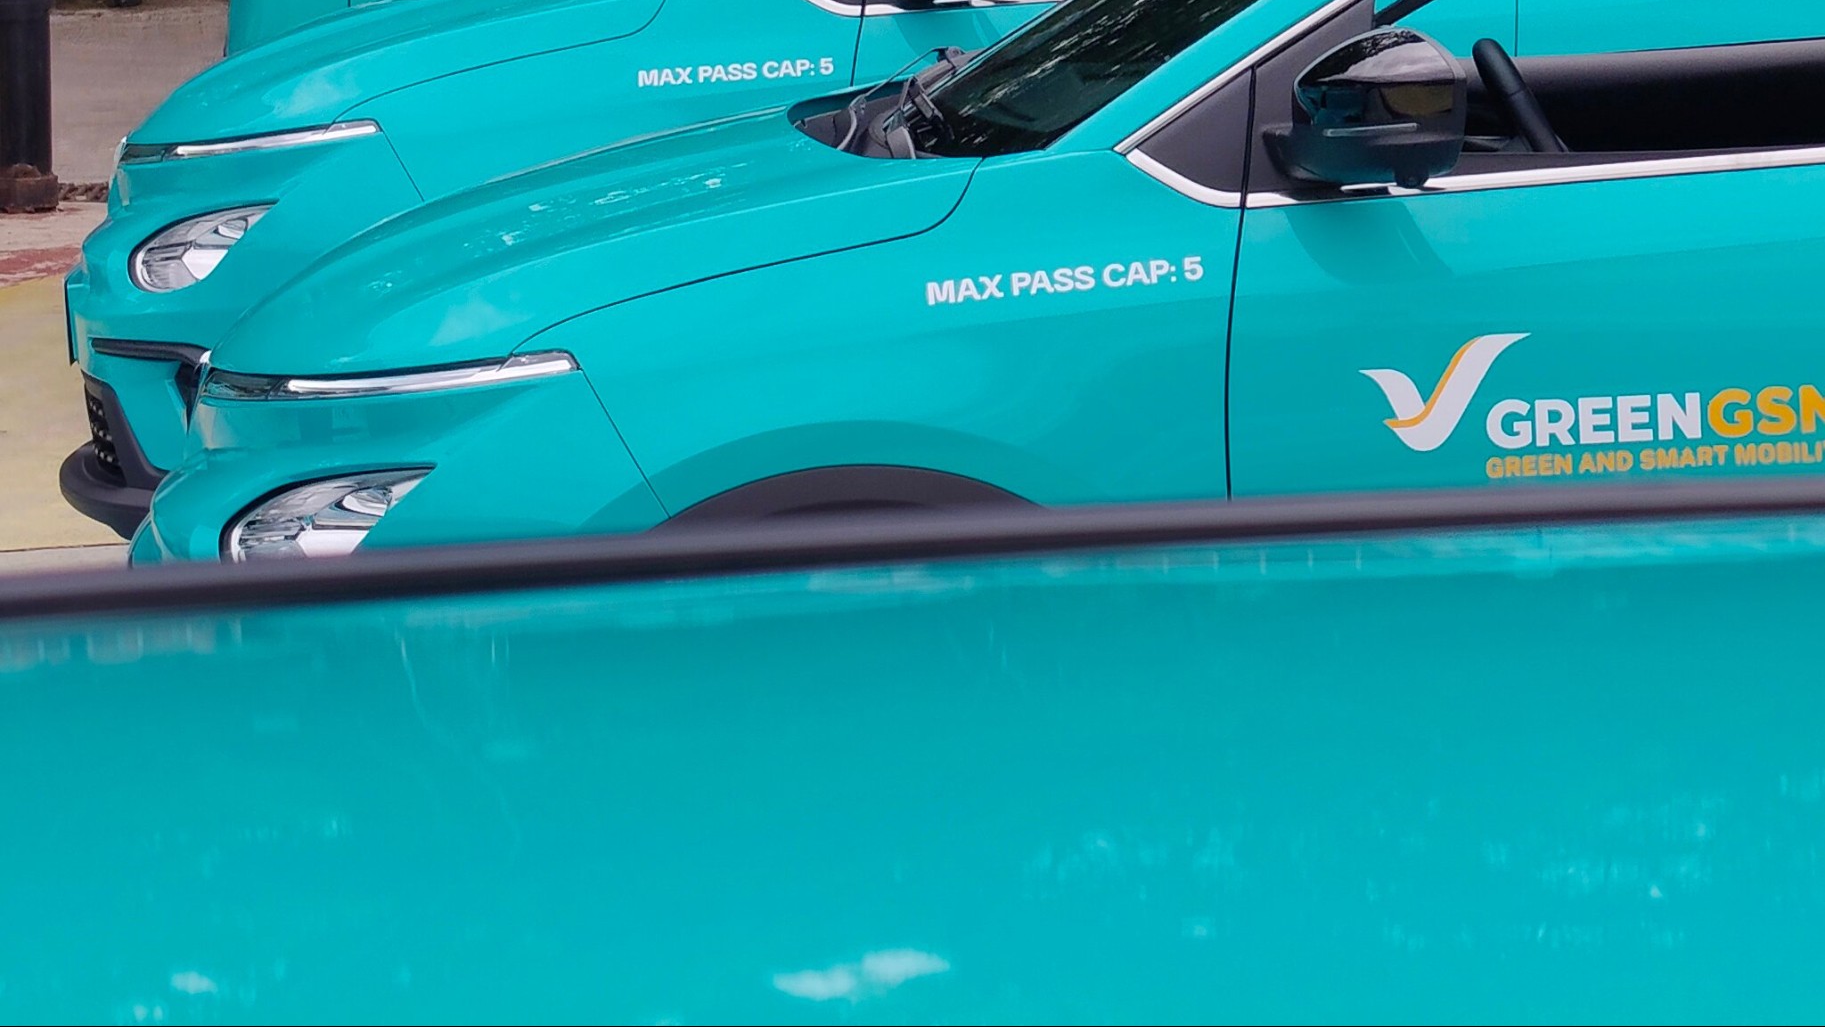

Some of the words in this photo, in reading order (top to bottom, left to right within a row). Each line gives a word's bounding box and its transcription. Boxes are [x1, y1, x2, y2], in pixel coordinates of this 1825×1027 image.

[638, 67, 693, 88] MAX
[698, 62, 757, 82] PASS
[762, 58, 815, 78] CAP:
[820, 57, 834, 75] 5
[926, 274, 1004, 306] MAX
[1011, 265, 1095, 296] PASS
[1102, 259, 1177, 287] CAP:
[1183, 256, 1204, 281] 5
[1485, 452, 1573, 479] GREEN
[1579, 449, 1634, 473] AND
[1640, 444, 1727, 470] SMART
